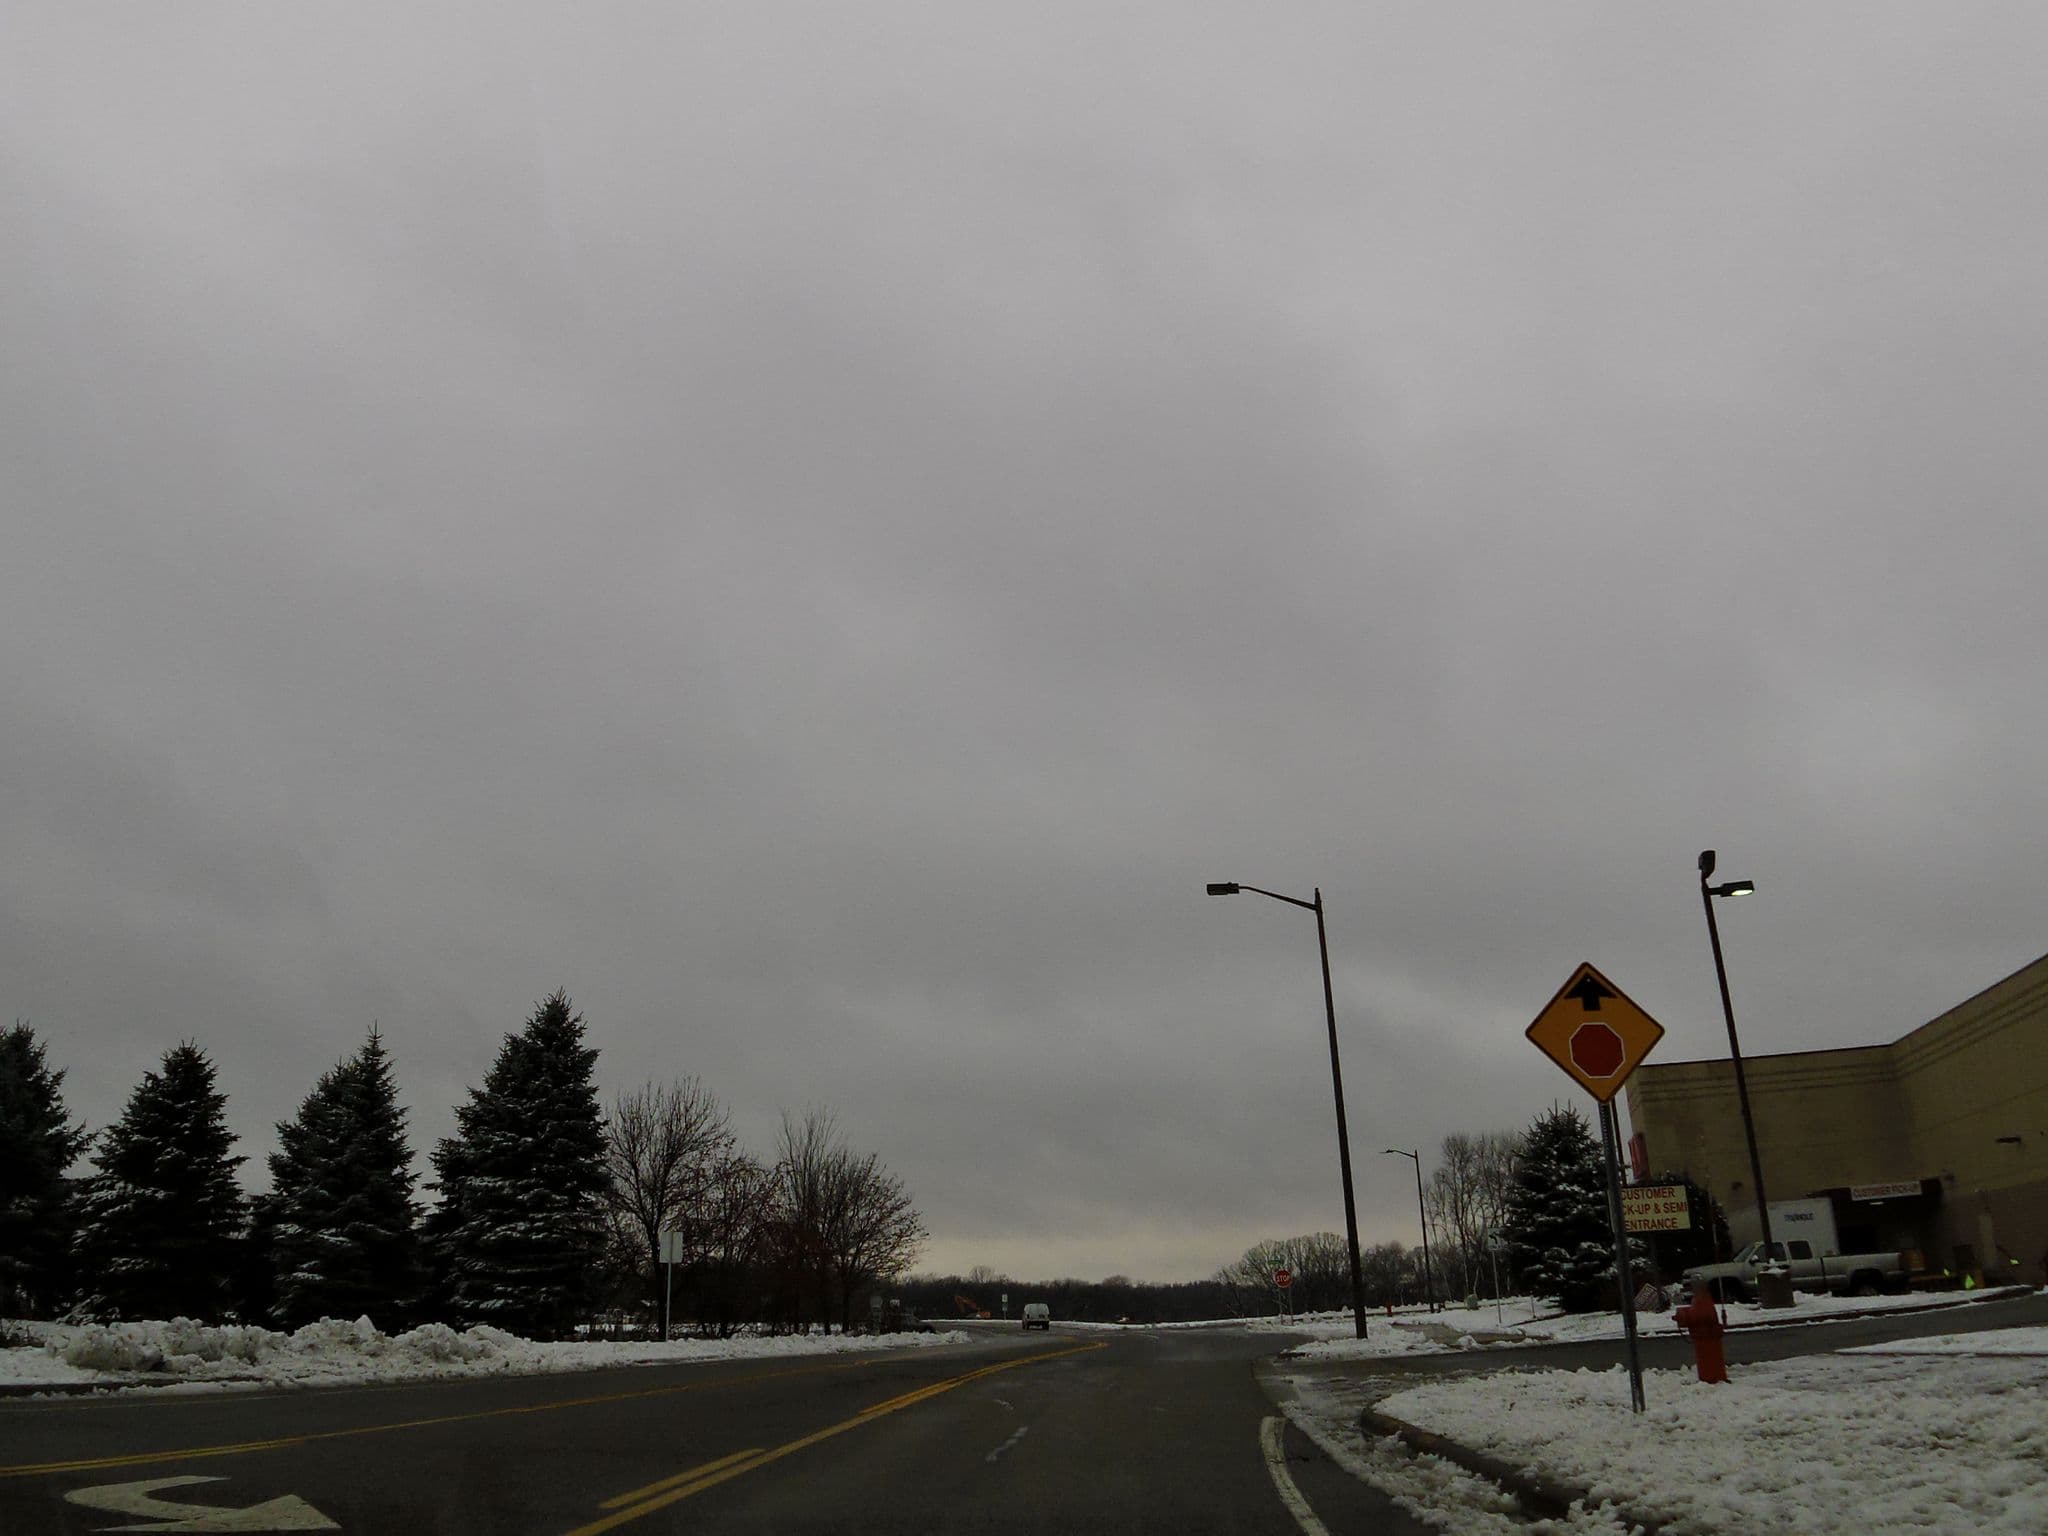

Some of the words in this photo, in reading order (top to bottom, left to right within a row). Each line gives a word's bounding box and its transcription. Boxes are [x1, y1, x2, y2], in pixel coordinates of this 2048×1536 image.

[1621, 1187, 1675, 1200] CUSTOMER
[1654, 1203, 1661, 1214] &
[1625, 1218, 1678, 1230] ENTRANCE
